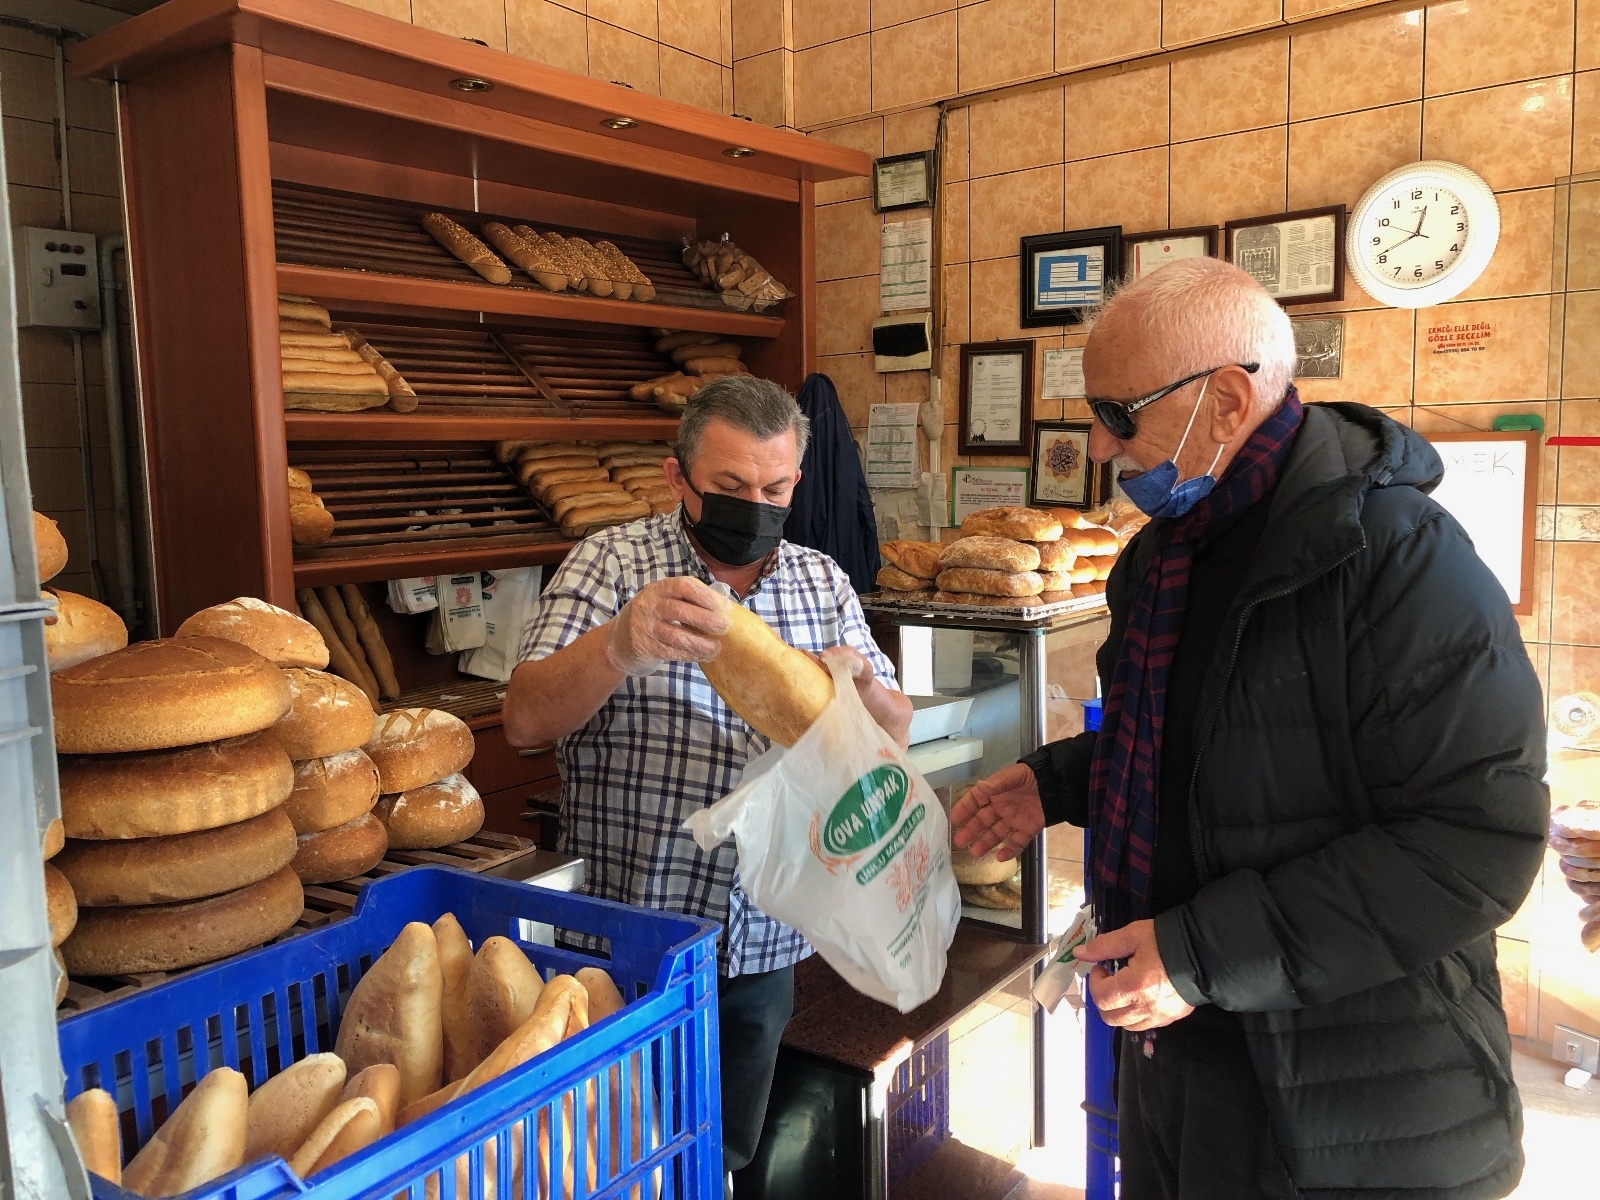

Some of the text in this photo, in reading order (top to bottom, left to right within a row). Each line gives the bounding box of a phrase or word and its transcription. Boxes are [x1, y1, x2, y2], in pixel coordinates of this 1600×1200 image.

[1411, 190, 1423, 200] 12
[1434, 192, 1438, 201] 1
[1394, 199, 1400, 209] 11
[1450, 205, 1459, 215] 2
[1378, 218, 1390, 227] 10
[1456, 222, 1464, 232] 3
[1372, 236, 1381, 246] 9
[1449, 243, 1459, 253] 4
[1378, 254, 1388, 264] 8
[1435, 259, 1444, 270] 5
[1394, 266, 1402, 276] 7
[1413, 268, 1423, 278] 6
[1454, 324, 1470, 333] ELLE
[1428, 333, 1454, 343] GÖZLE
[833, 772, 901, 846] OVA UNPAK
